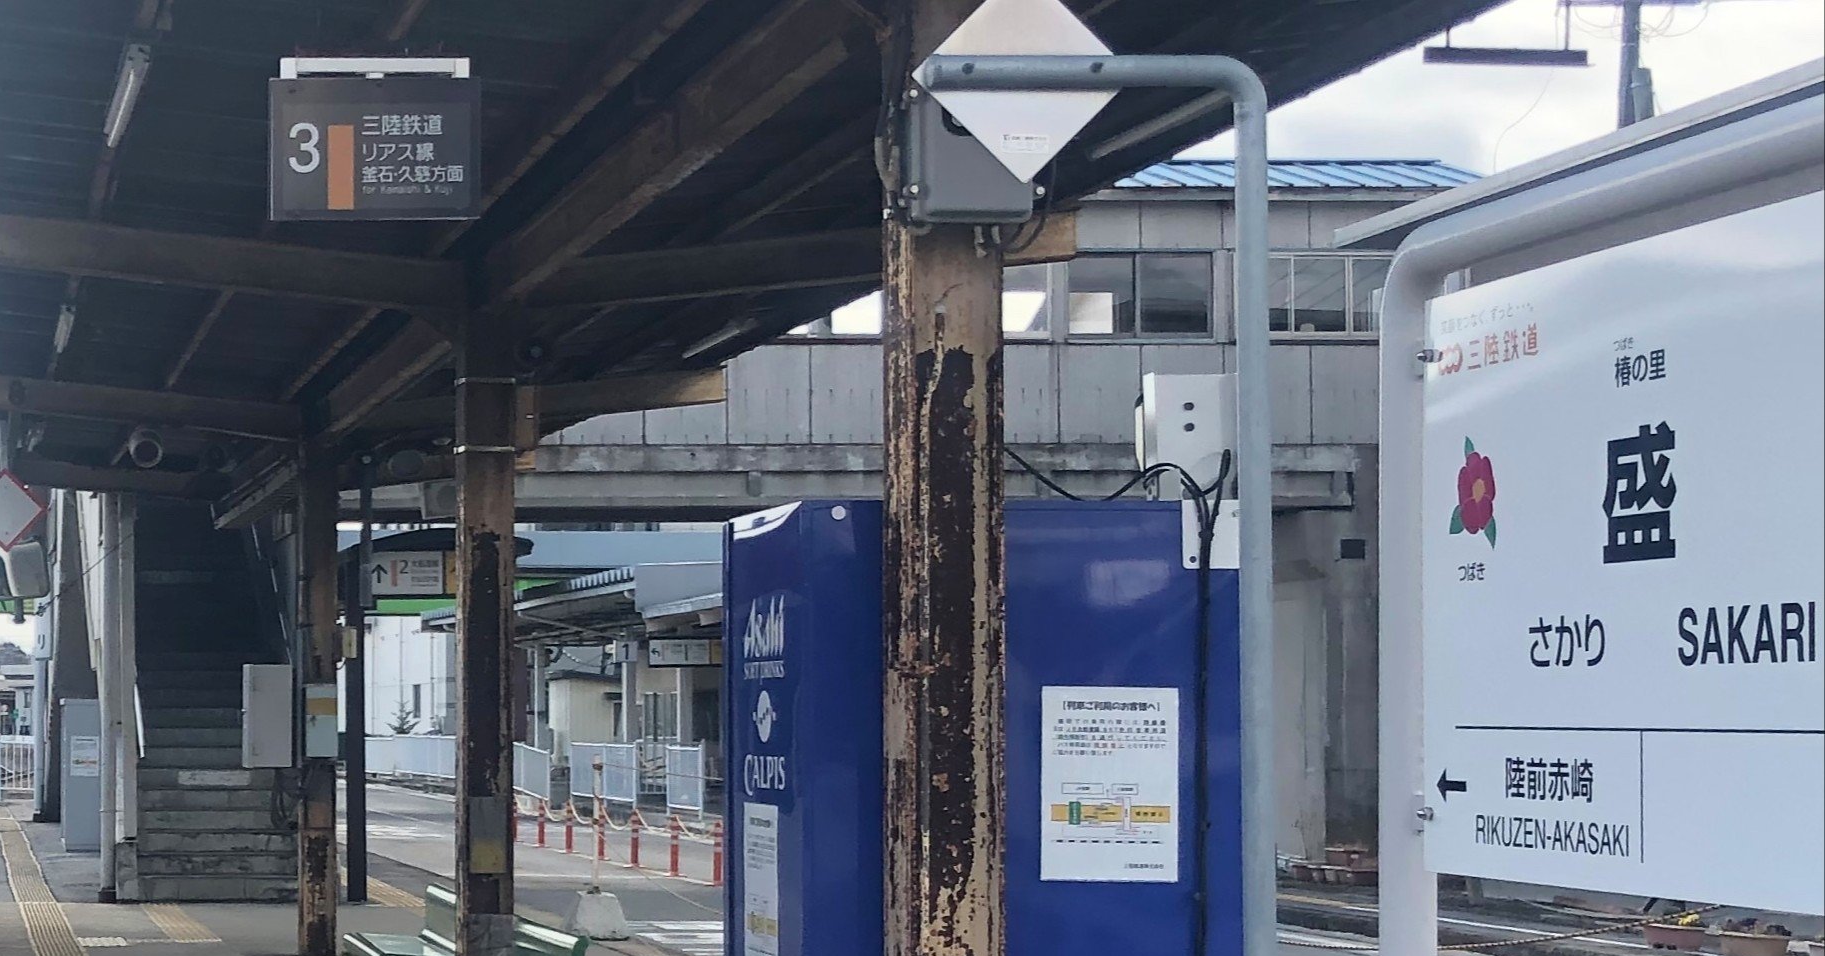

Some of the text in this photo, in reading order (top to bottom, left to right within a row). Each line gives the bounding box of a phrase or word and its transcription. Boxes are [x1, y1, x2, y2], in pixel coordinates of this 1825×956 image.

[288, 122, 321, 173] 3
[361, 114, 444, 136] 三陸鉄道
[362, 143, 435, 162] リアス線
[1468, 322, 1539, 368] 三陸鉄道
[1614, 348, 1667, 389] 椿の里
[1602, 420, 1677, 565] 盛
[399, 559, 410, 574] 2
[1457, 561, 1486, 581] つばき
[743, 594, 785, 659] Asahi
[1528, 613, 1606, 668] さかり
[1677, 601, 1816, 666] SAKARI
[743, 754, 786, 796] CALPIS
[1505, 756, 1594, 804] 陸前赤崎
[1475, 814, 1630, 858] RIKUZEN-AKASAKI
